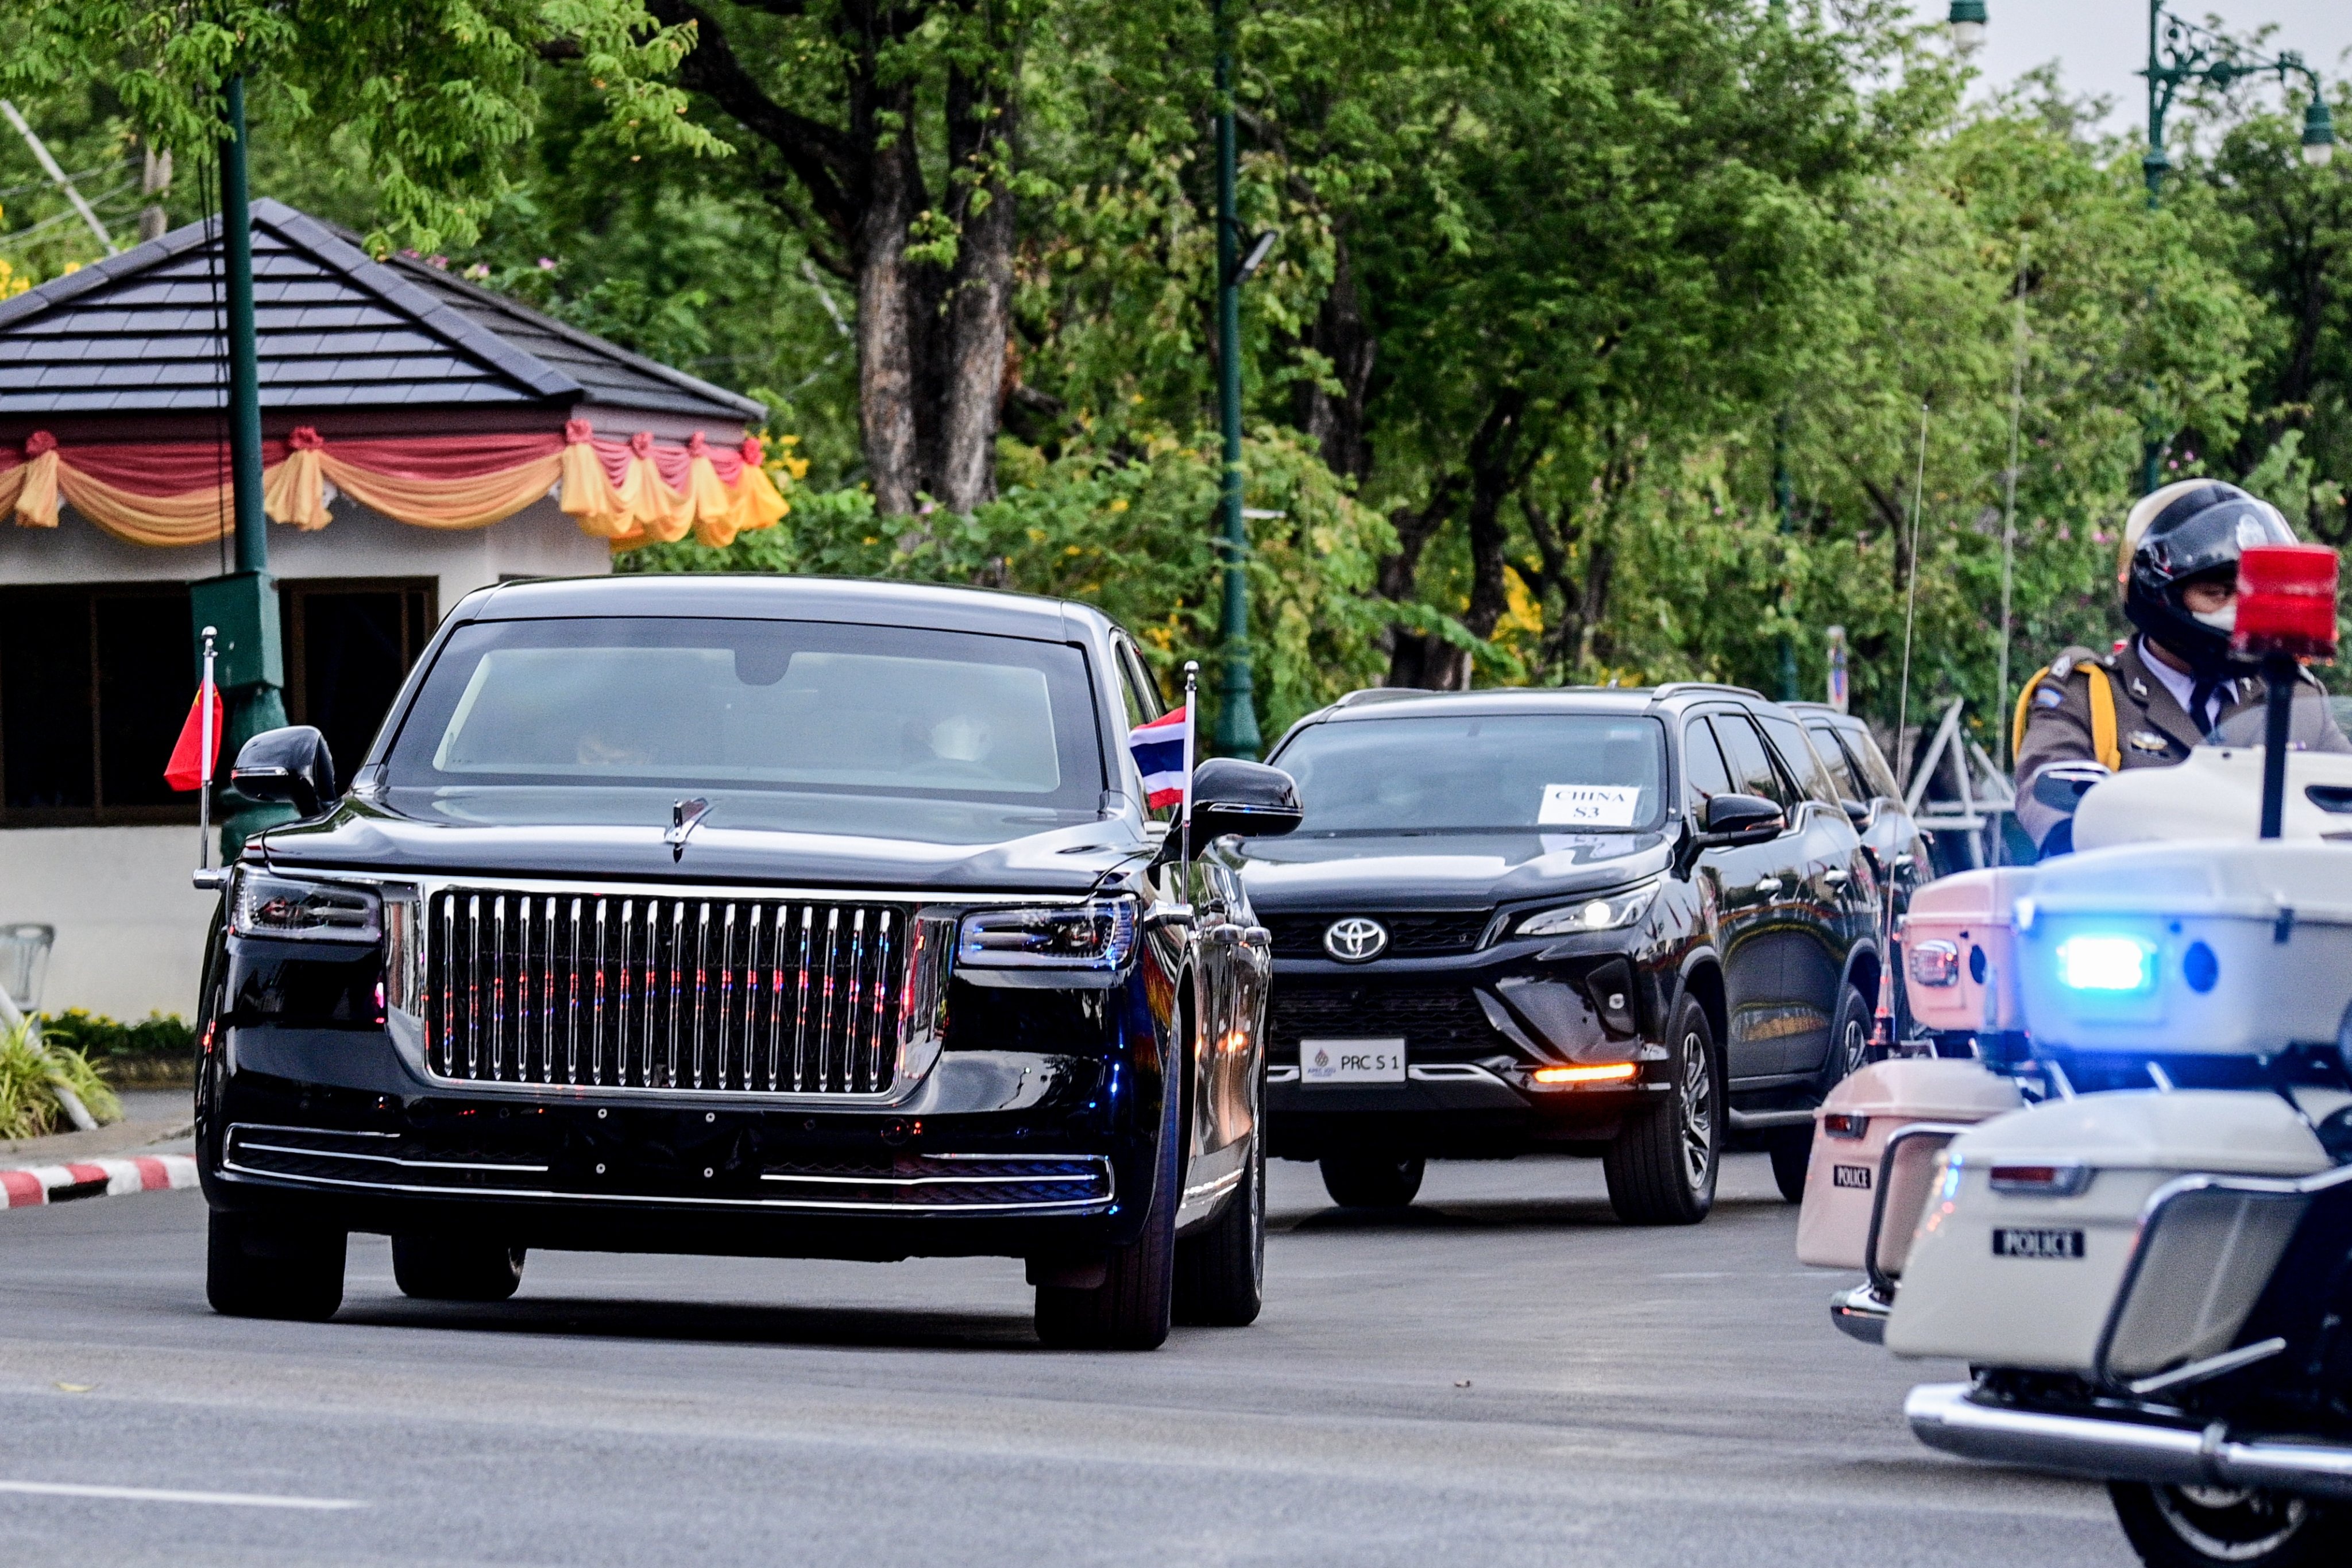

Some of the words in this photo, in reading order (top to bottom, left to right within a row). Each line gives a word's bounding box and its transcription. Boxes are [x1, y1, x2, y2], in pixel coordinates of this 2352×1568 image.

[1555, 790, 1625, 802] CHINA
[1573, 806, 1600, 818] S3
[1341, 1055, 1371, 1071] PRC
[1376, 1055, 1386, 1070] S
[1392, 1055, 1399, 1070] 1
[1837, 1166, 1868, 1188] POLICE
[2003, 1231, 2073, 1257] POLICE
